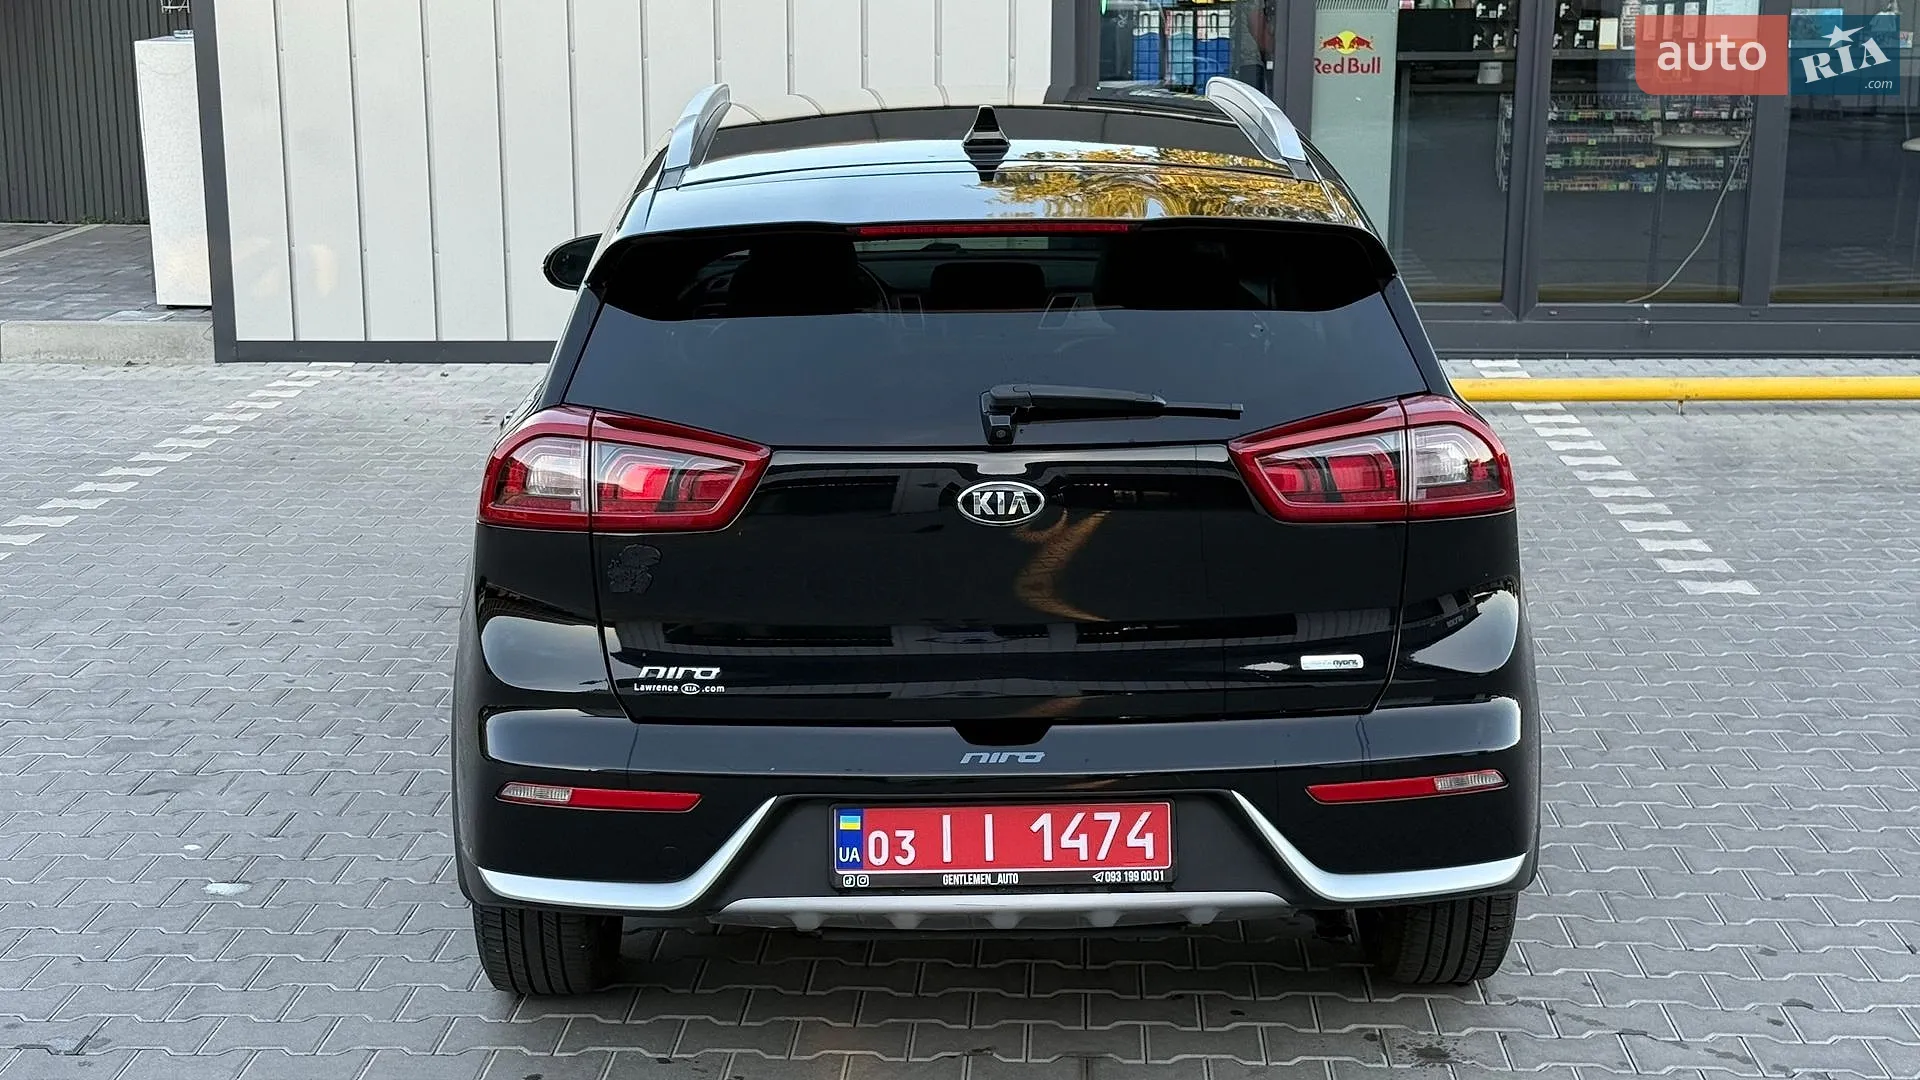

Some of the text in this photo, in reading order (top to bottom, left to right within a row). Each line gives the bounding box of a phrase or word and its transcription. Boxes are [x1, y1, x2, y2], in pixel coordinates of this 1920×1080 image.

[1313, 56, 1381, 74] Red Bull
[972, 491, 1031, 515] KIA
[638, 666, 721, 680] niro
[634, 683, 678, 692] Lawrence
[960, 751, 1045, 764] niro
[867, 829, 916, 866] 03
[1030, 811, 1155, 862] 1474
[838, 847, 861, 863] UA
[1105, 870, 1164, 882] 093 199 00 01
